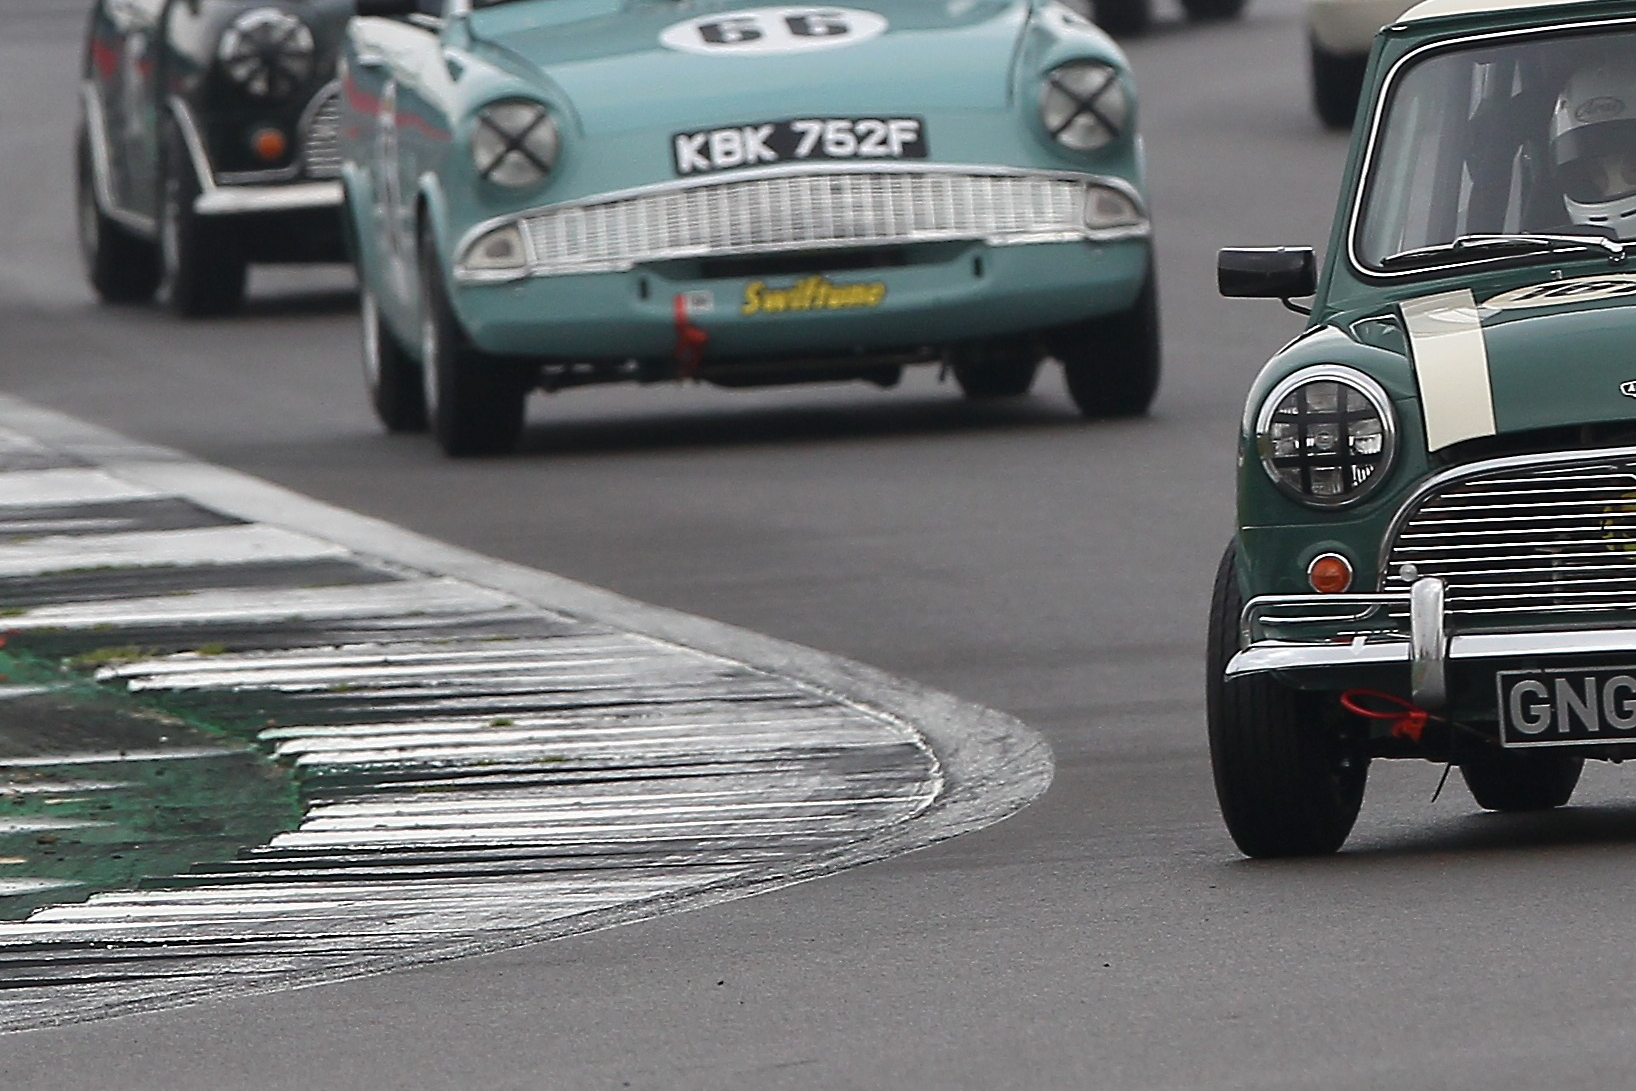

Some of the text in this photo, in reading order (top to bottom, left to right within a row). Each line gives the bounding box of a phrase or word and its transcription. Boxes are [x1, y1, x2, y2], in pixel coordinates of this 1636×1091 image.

[698, 11, 849, 45] 66
[674, 118, 920, 173] KBK 752F
[742, 275, 887, 315] Swiftune
